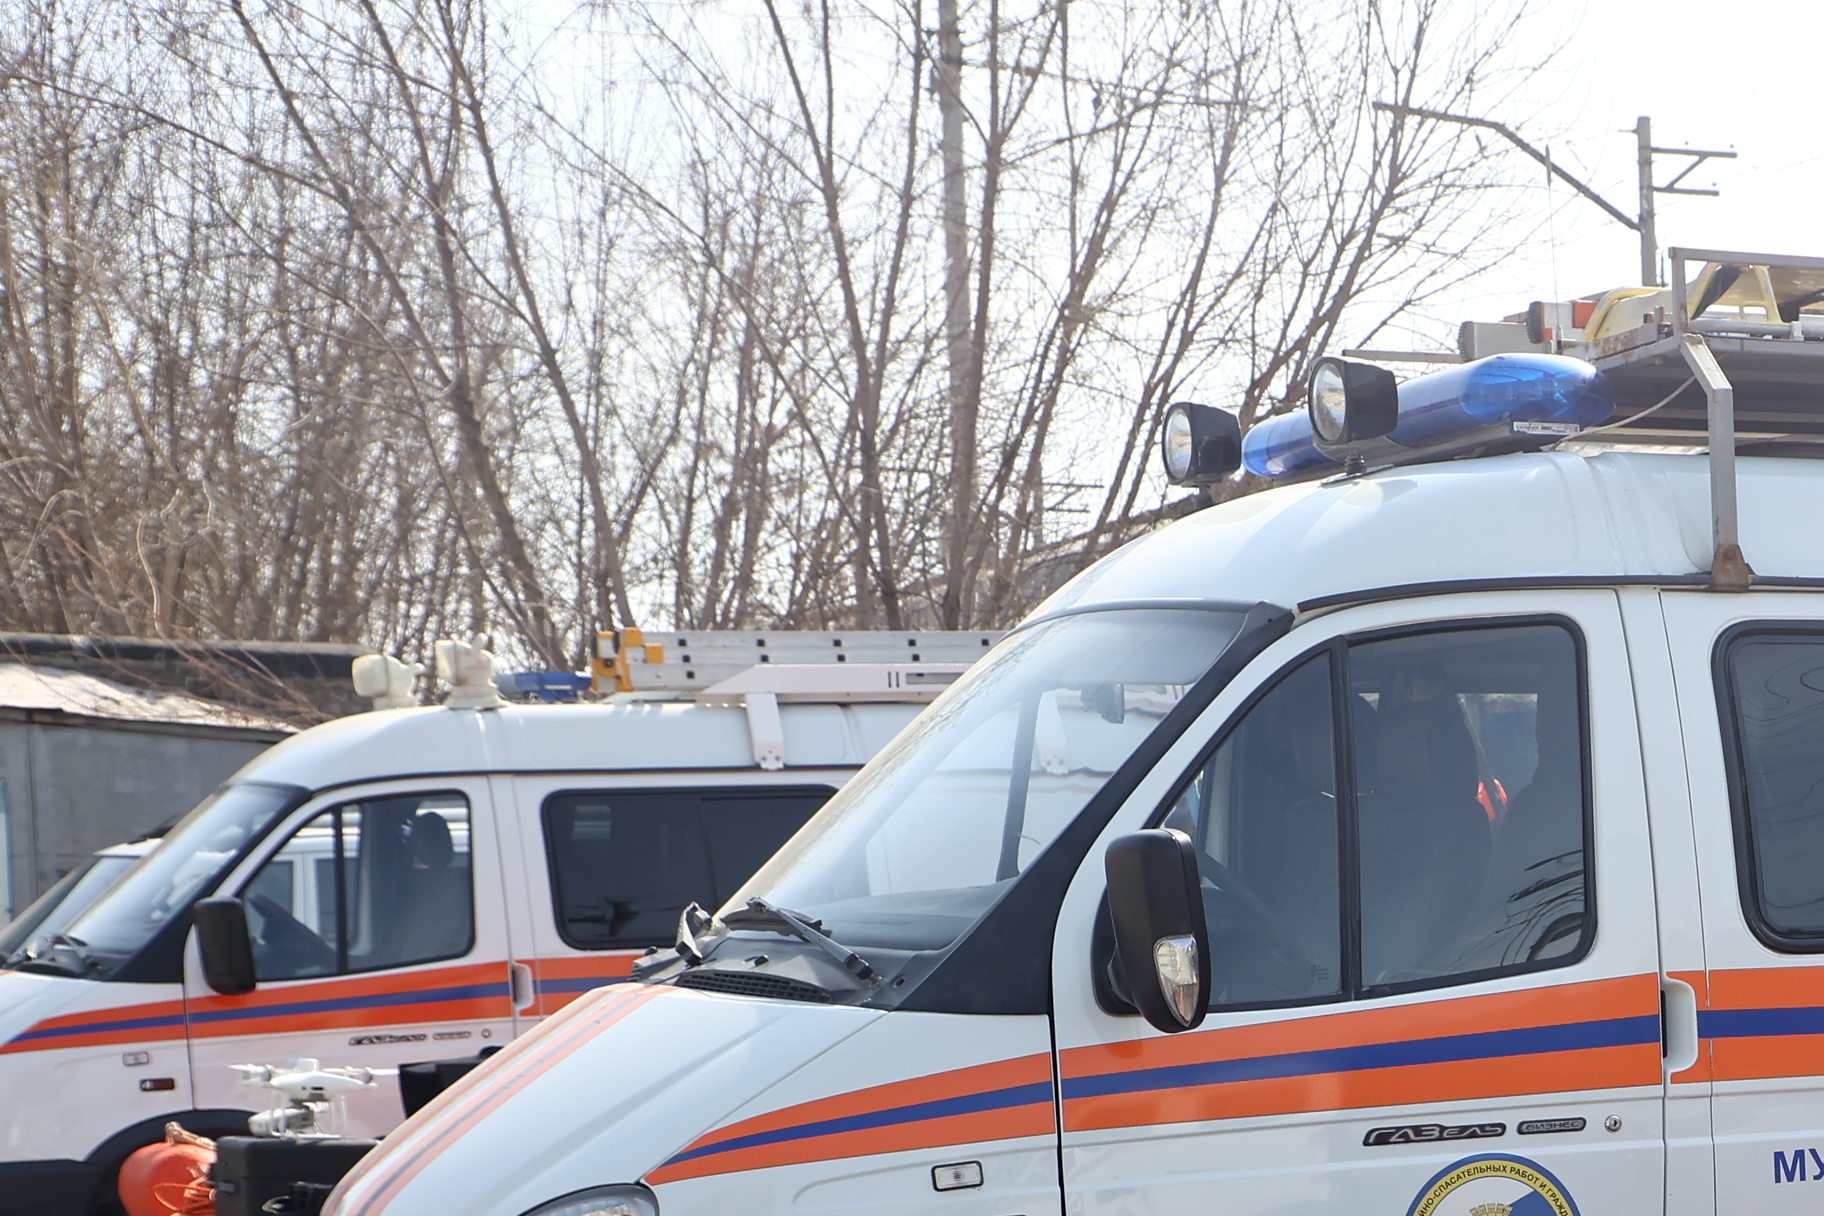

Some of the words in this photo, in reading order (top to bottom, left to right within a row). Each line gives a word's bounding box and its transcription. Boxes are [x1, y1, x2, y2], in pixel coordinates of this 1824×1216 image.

[1525, 1120, 1581, 1132] БИЗНЕС
[1509, 1167, 1541, 1185] РАБОТ
[1538, 1181, 1547, 1190] И
